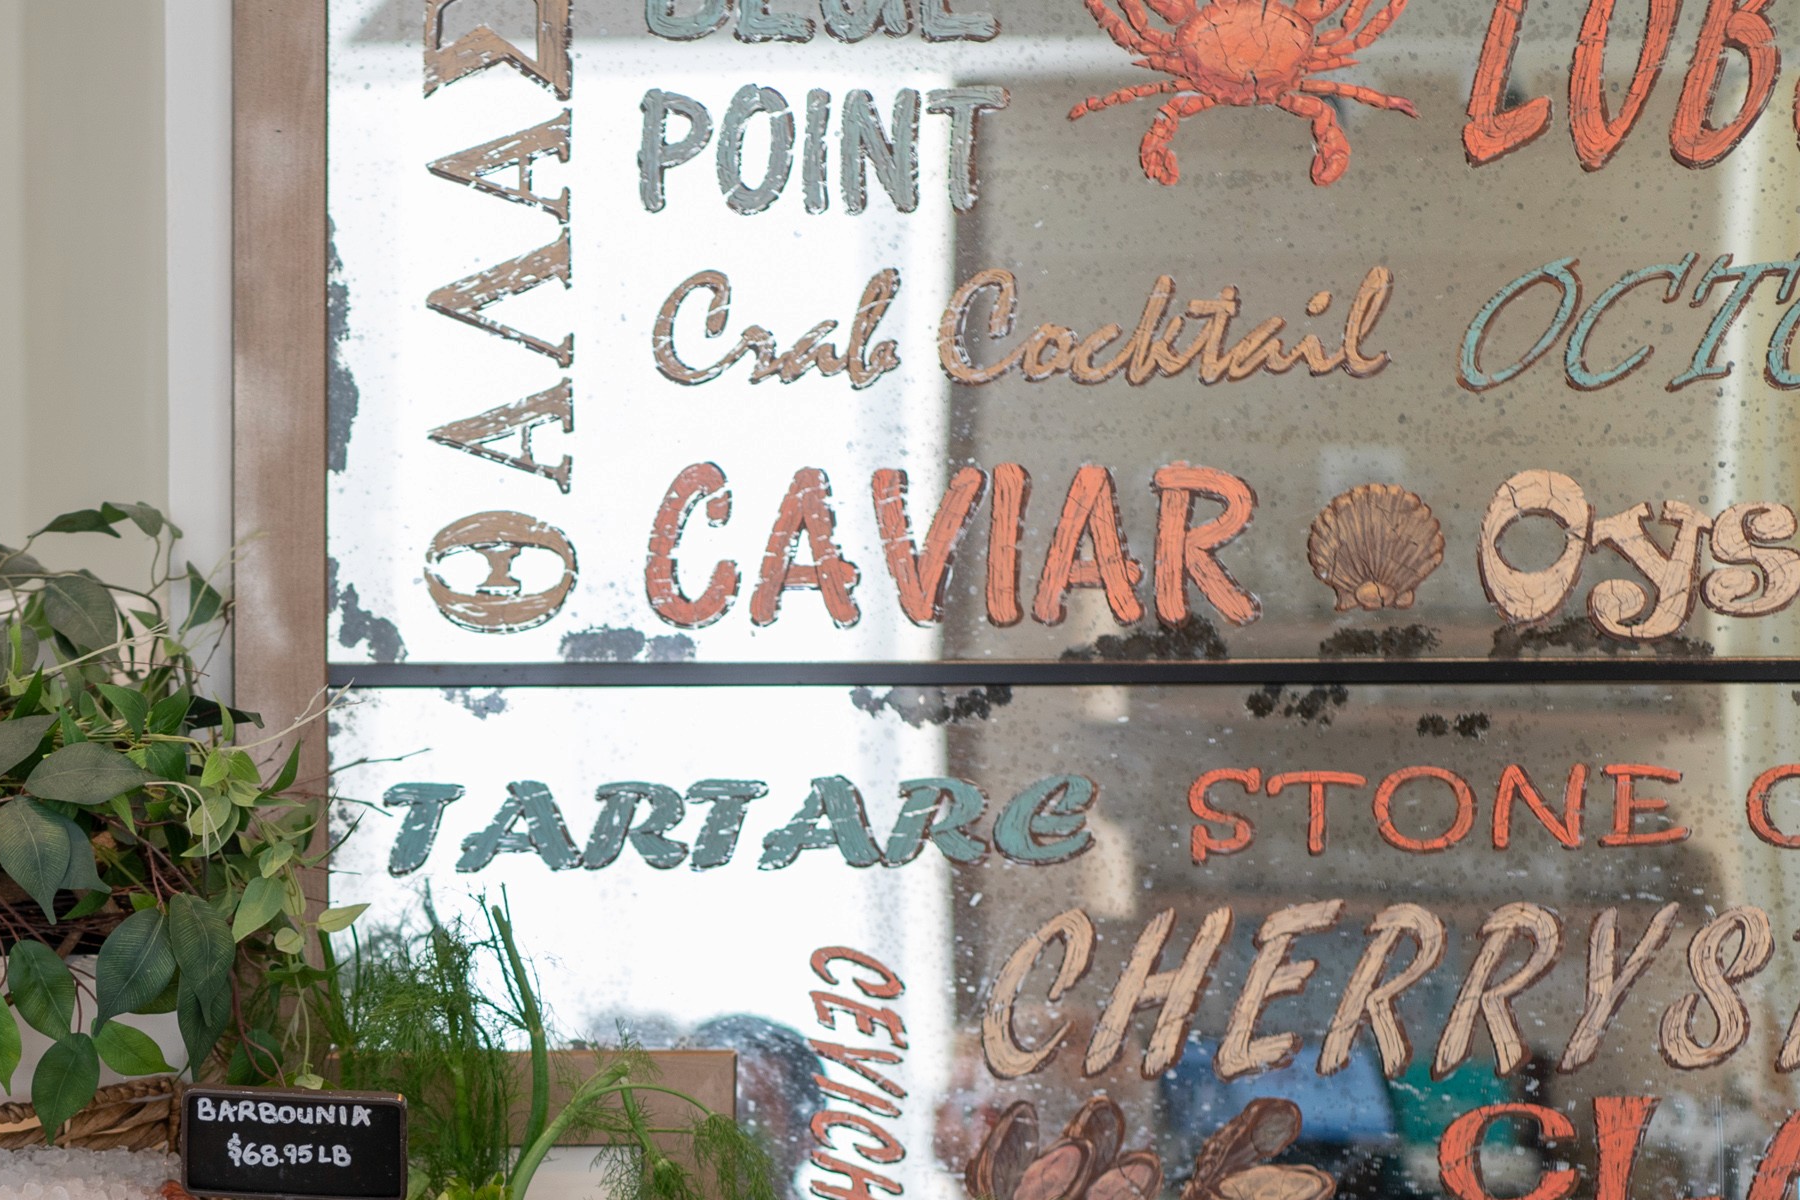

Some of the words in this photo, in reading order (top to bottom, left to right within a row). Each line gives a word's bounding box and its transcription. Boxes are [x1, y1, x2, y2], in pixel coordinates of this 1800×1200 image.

[638, 83, 1011, 216] POINT
[652, 267, 902, 390] Crab
[937, 266, 1394, 386] Cocktail
[645, 460, 1262, 629] CAVIAR
[1187, 762, 1692, 865] STONE
[981, 898, 1800, 1081] CHERRYS
[197, 1097, 372, 1127] BARBOUNIA
[227, 1132, 314, 1167] $68.95
[318, 1144, 352, 1167] LB
